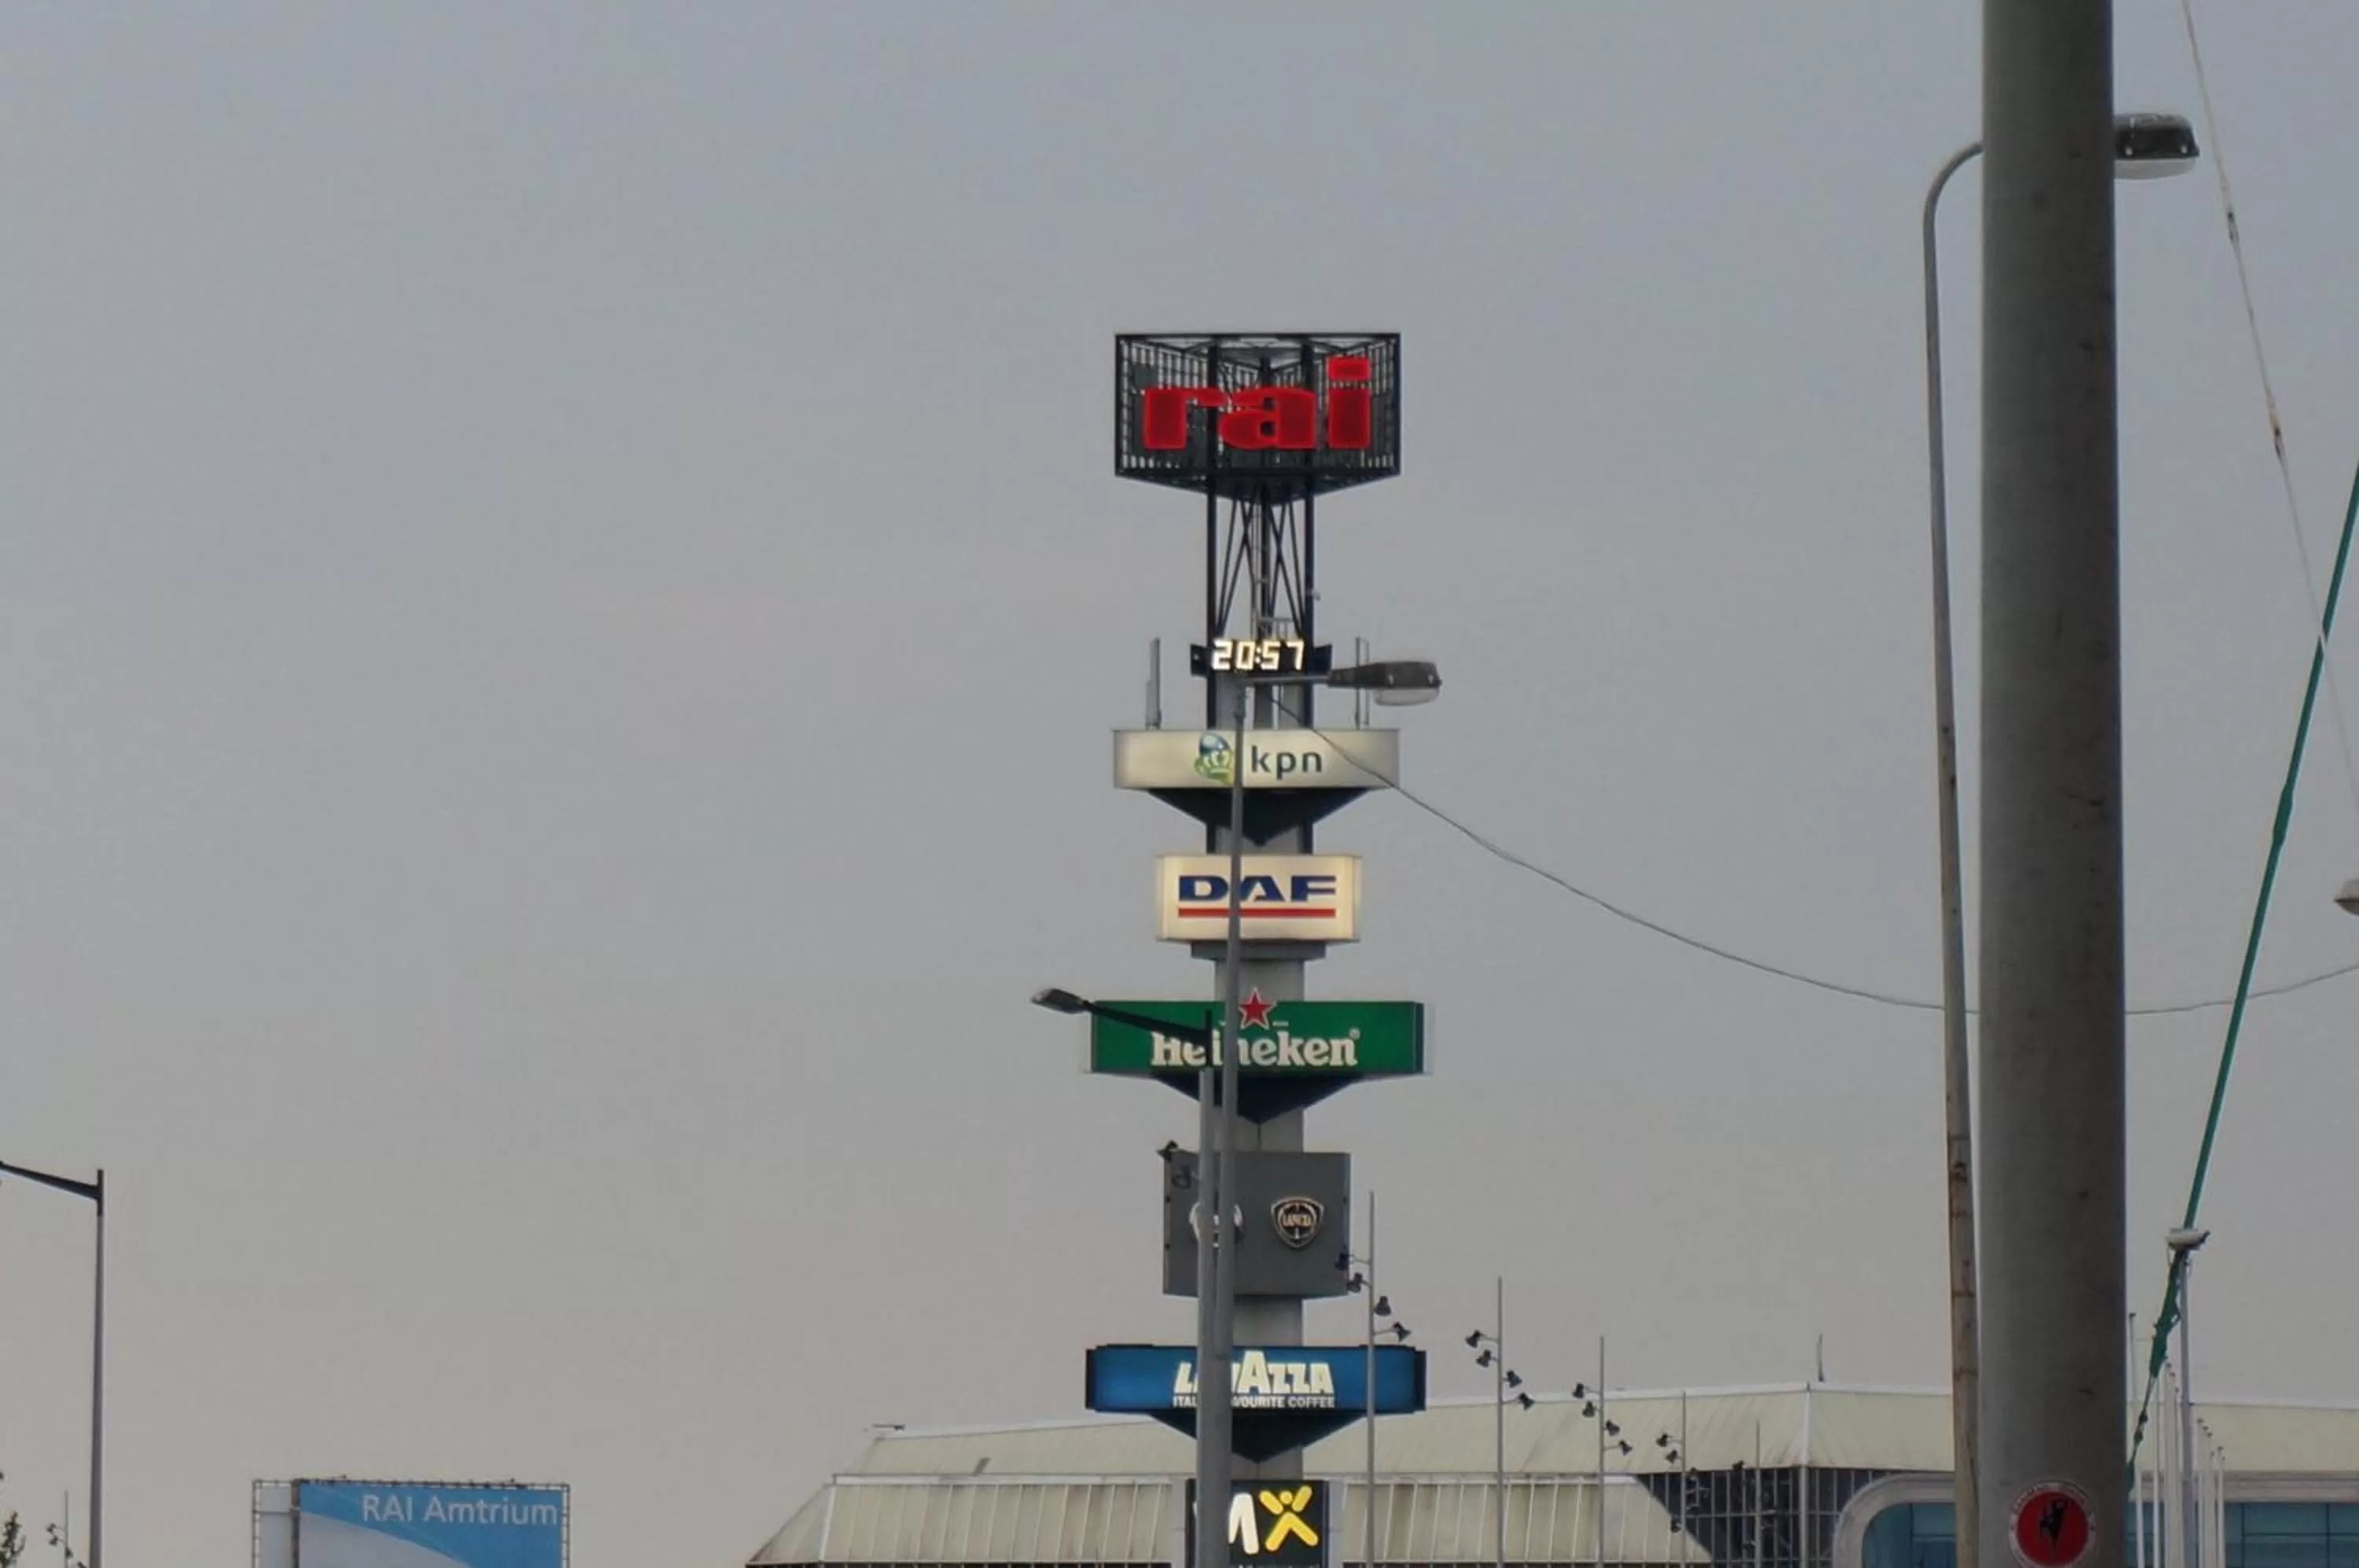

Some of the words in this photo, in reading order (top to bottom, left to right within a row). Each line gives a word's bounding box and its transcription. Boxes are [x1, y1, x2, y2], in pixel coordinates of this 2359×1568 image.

[1143, 356, 1371, 449] rai
[1212, 639, 1304, 669] 20:57
[1250, 745, 1323, 779] kpn
[1179, 875, 1336, 902] DAF
[1173, 1350, 1334, 1393] LAZZA
[1287, 1396, 1335, 1408] COFFEE
[362, 1495, 413, 1522] RAI
[423, 1496, 558, 1526] Amtrium
